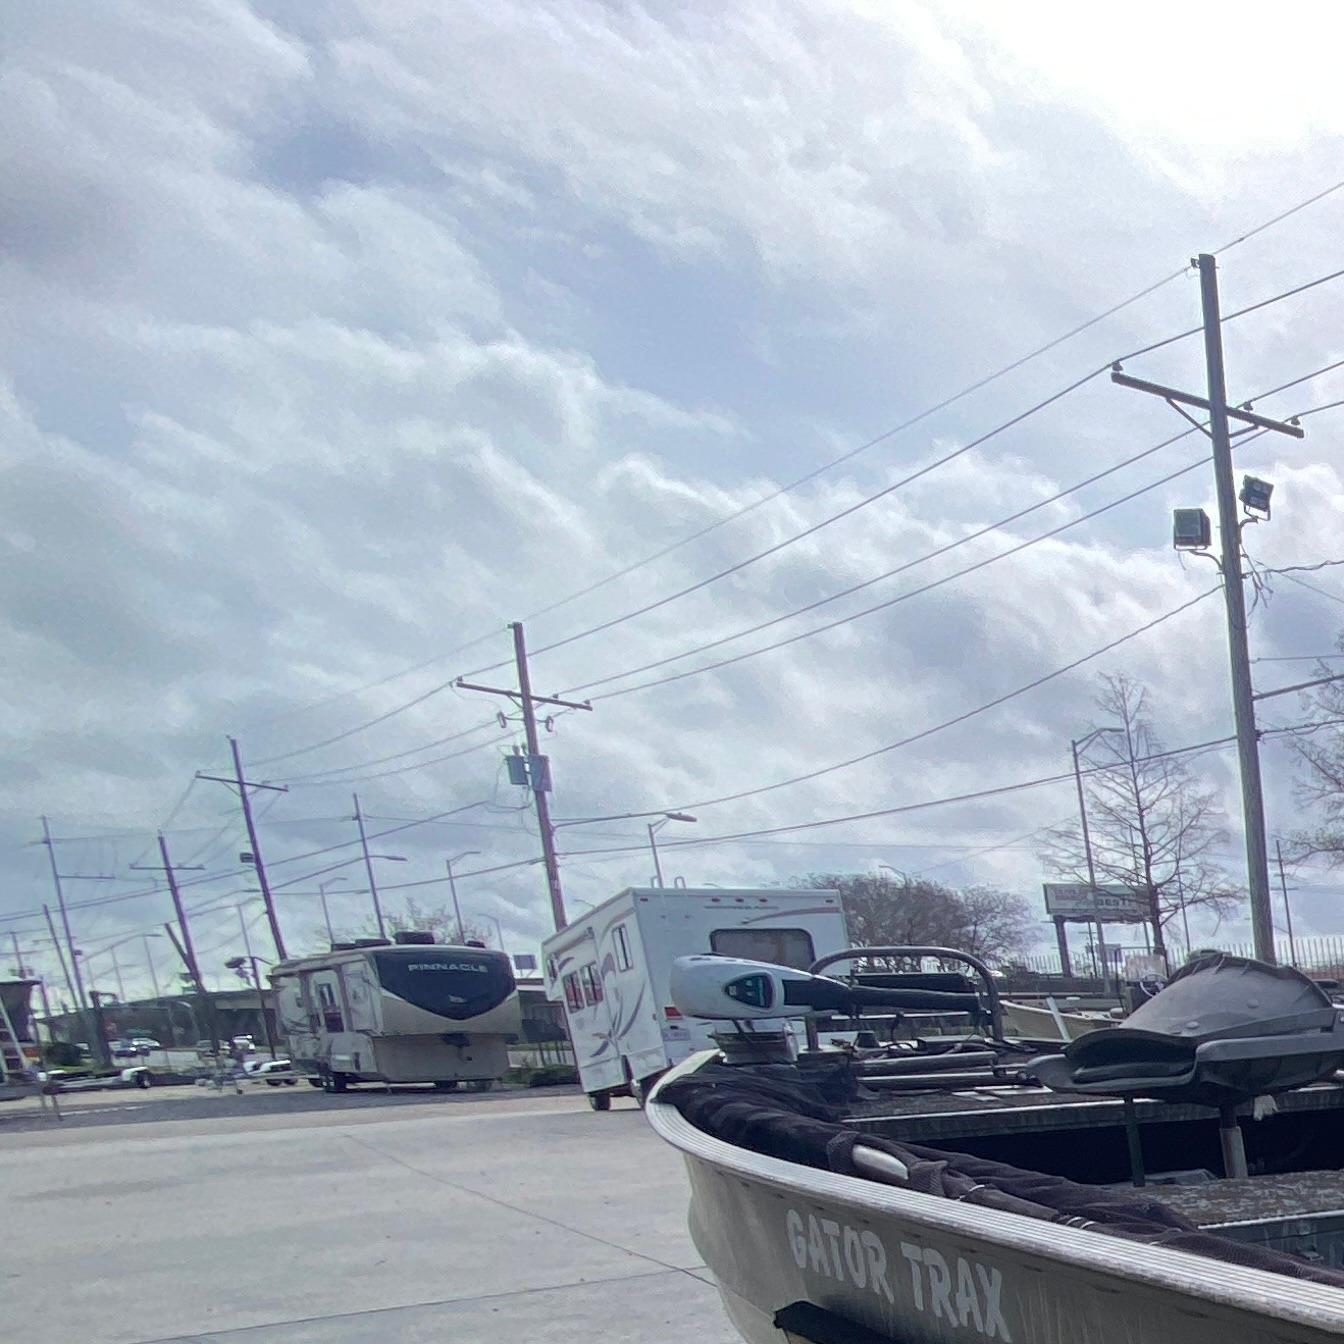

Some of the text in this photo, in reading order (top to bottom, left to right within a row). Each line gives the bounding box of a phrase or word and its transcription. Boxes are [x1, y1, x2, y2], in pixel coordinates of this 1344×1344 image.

[407, 963, 489, 973] PINNACLE
[787, 1208, 1012, 1343] GATOR TRAX
